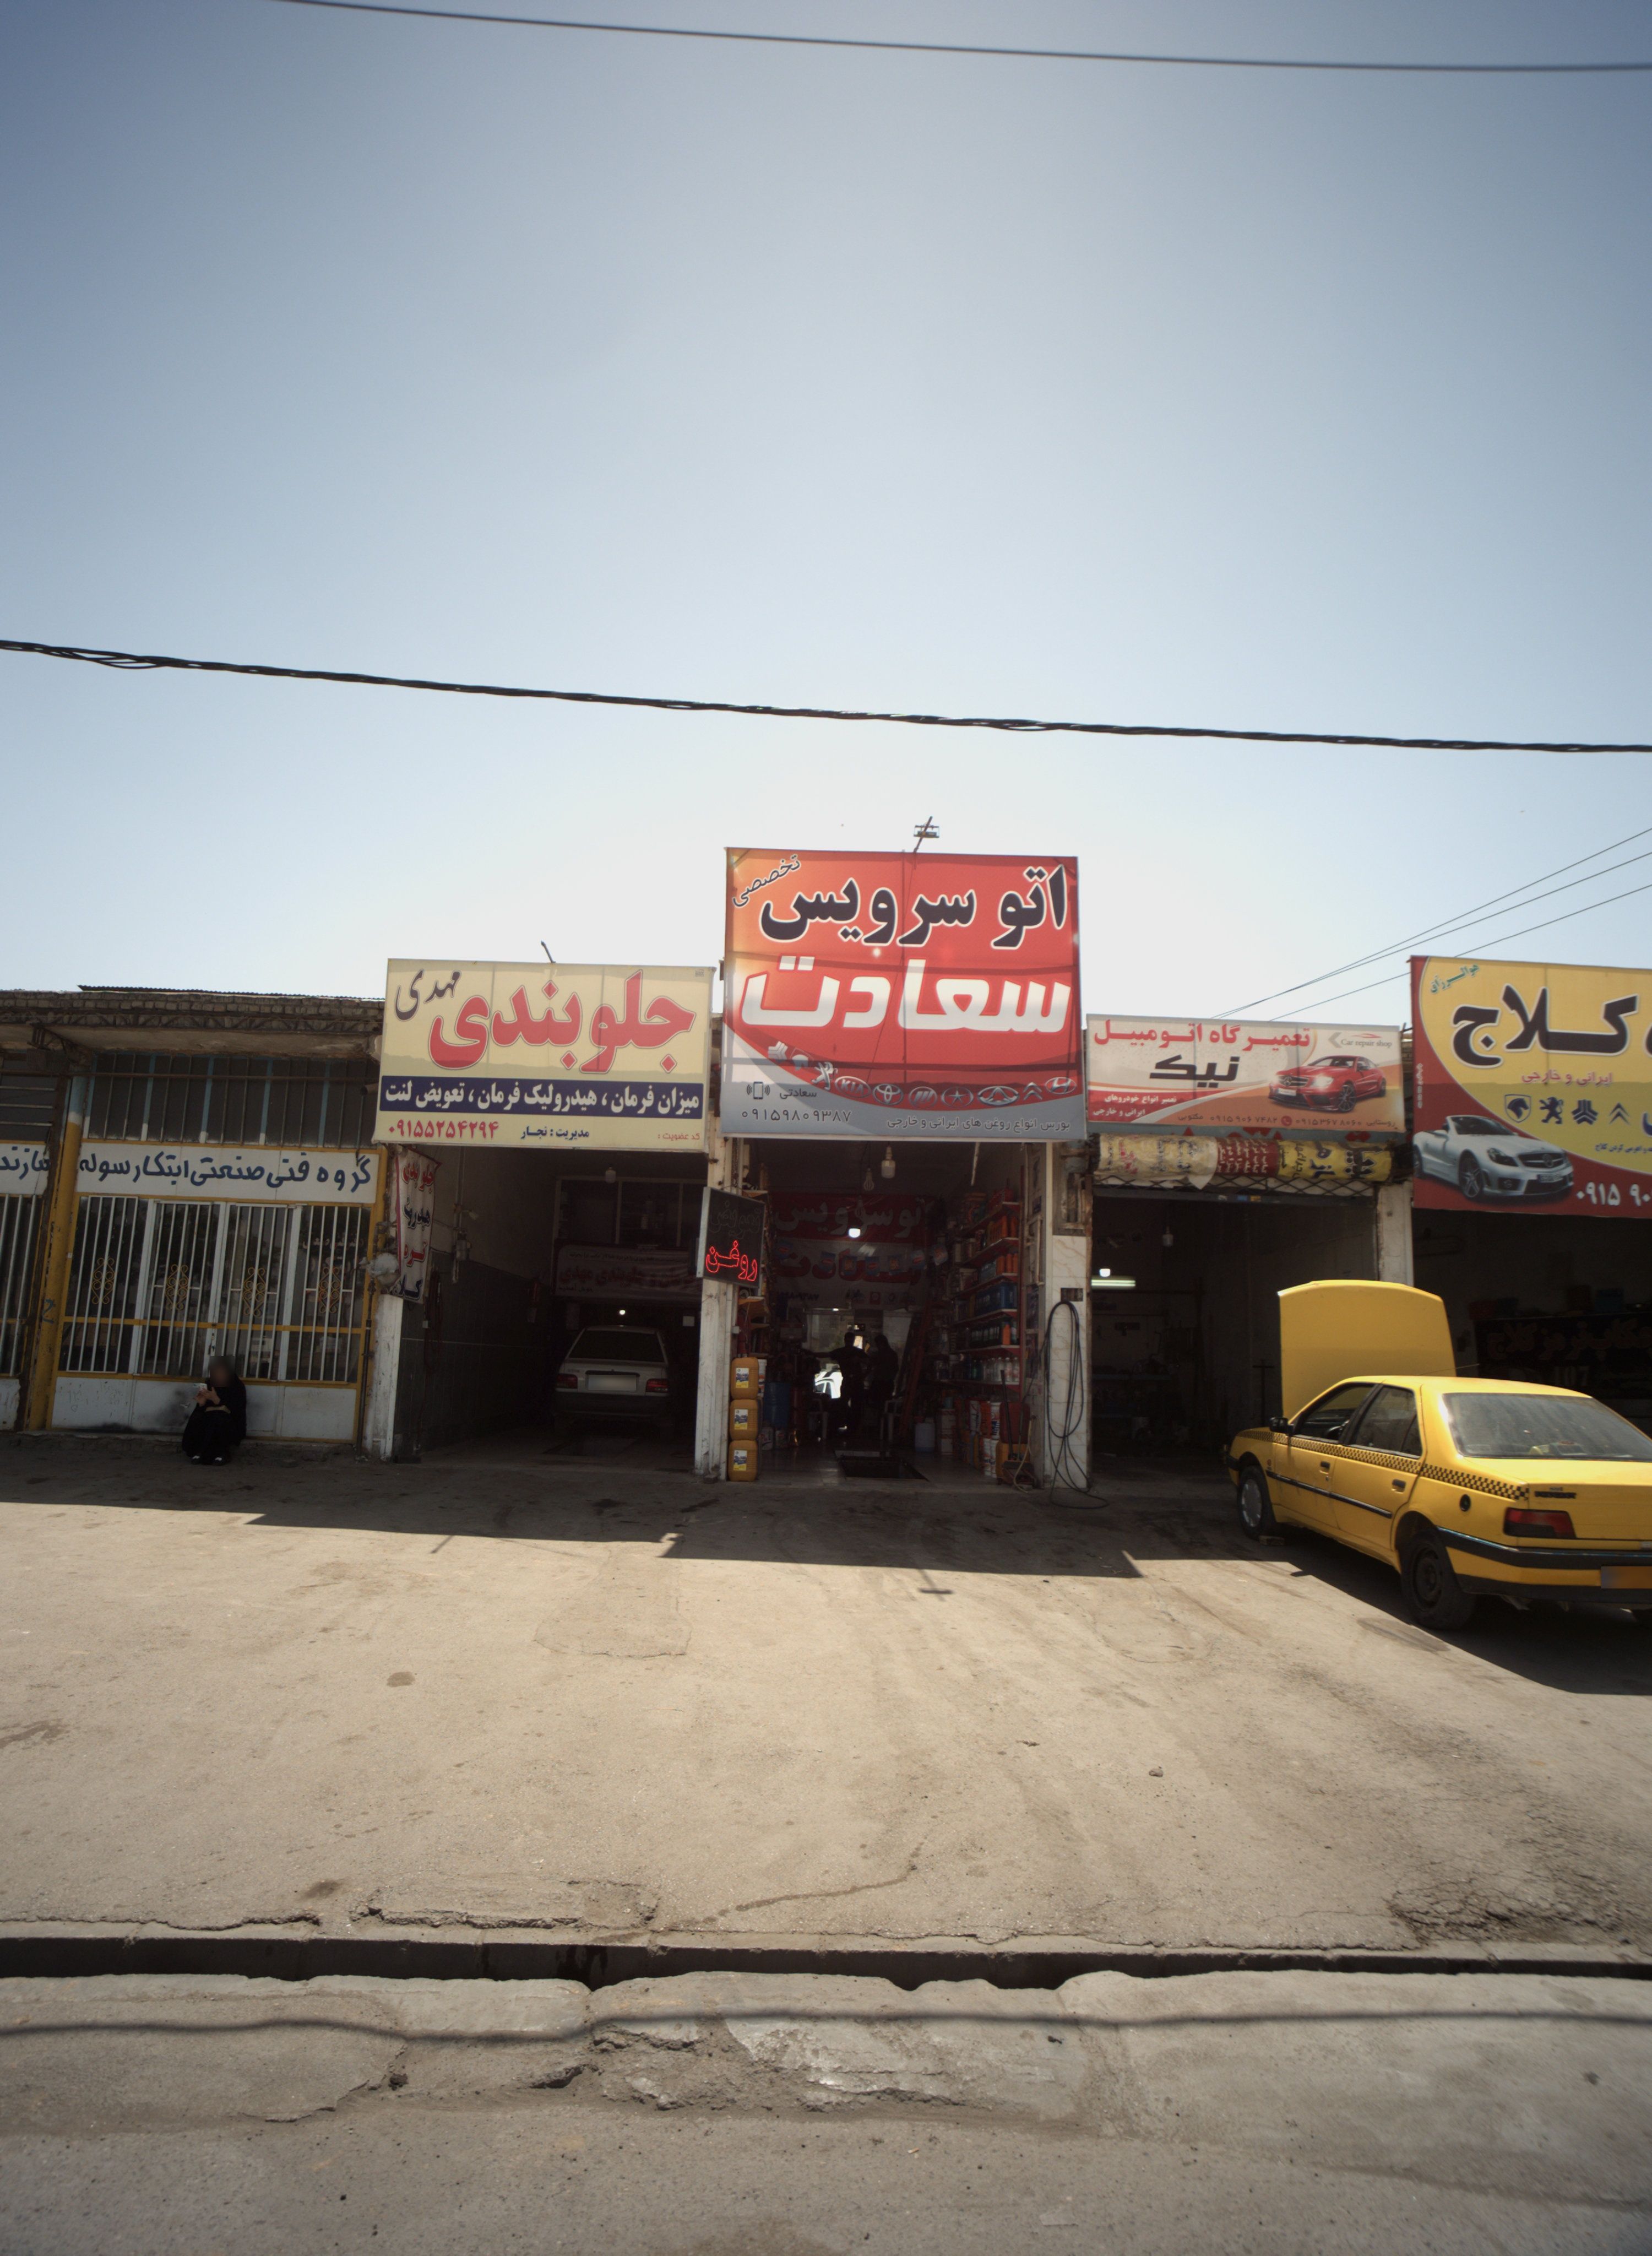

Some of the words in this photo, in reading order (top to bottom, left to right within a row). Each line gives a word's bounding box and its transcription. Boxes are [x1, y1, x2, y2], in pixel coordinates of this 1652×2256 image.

[732, 855, 802, 908] تخصصی
[759, 877, 976, 947] سرویس
[991, 864, 1067, 950] اتو
[394, 969, 461, 1021] مهدی
[741, 955, 1072, 1033] سعادت
[428, 969, 697, 1074] جلوبندی
[1452, 984, 1639, 1068] کلاج
[1094, 1019, 1203, 1048] اتومبیل
[1376, 1040, 1392, 1048] shop
[1149, 1054, 1241, 1088] نیک
[1521, 1069, 1562, 1084] خارجی
[1566, 1073, 1573, 1085] و
[1575, 1072, 1613, 1087] ایرانی
[385, 1080, 413, 1102] لنت
[415, 1082, 465, 1109] تعویض
[779, 1088, 817, 1099] سعادتی
[841, 1078, 865, 1095] KIA
[524, 1083, 597, 1111] هیدرولیک
[658, 1086, 699, 1115] میزان
[1104, 1094, 1139, 1103] خودروهای
[1141, 1096, 1159, 1104] انواع
[1093, 1107, 1117, 1116] خارجی
[1124, 1109, 1146, 1118] ایرانی
[887, 1115, 918, 1129] خارجی
[921, 1120, 926, 1128] و
[930, 1117, 959, 1129] ایرانی
[963, 1118, 981, 1129] های
[985, 1118, 1011, 1130] روغن
[1013, 1118, 1037, 1133] انواع
[1040, 1121, 1070, 1131] بورس
[520, 1126, 548, 1139] نجار
[556, 1129, 590, 1140] مدیریت
[662, 1132, 689, 1141] عضویت
[79, 1153, 131, 1182] سوله
[132, 1151, 189, 1185] ابتکار
[190, 1156, 265, 1186] صنعتی
[266, 1152, 310, 1188] فنی
[316, 1154, 371, 1193] گروه
[1576, 1181, 1621, 1206] ۰۹۱۵
[705, 1239, 758, 1282] روغن
